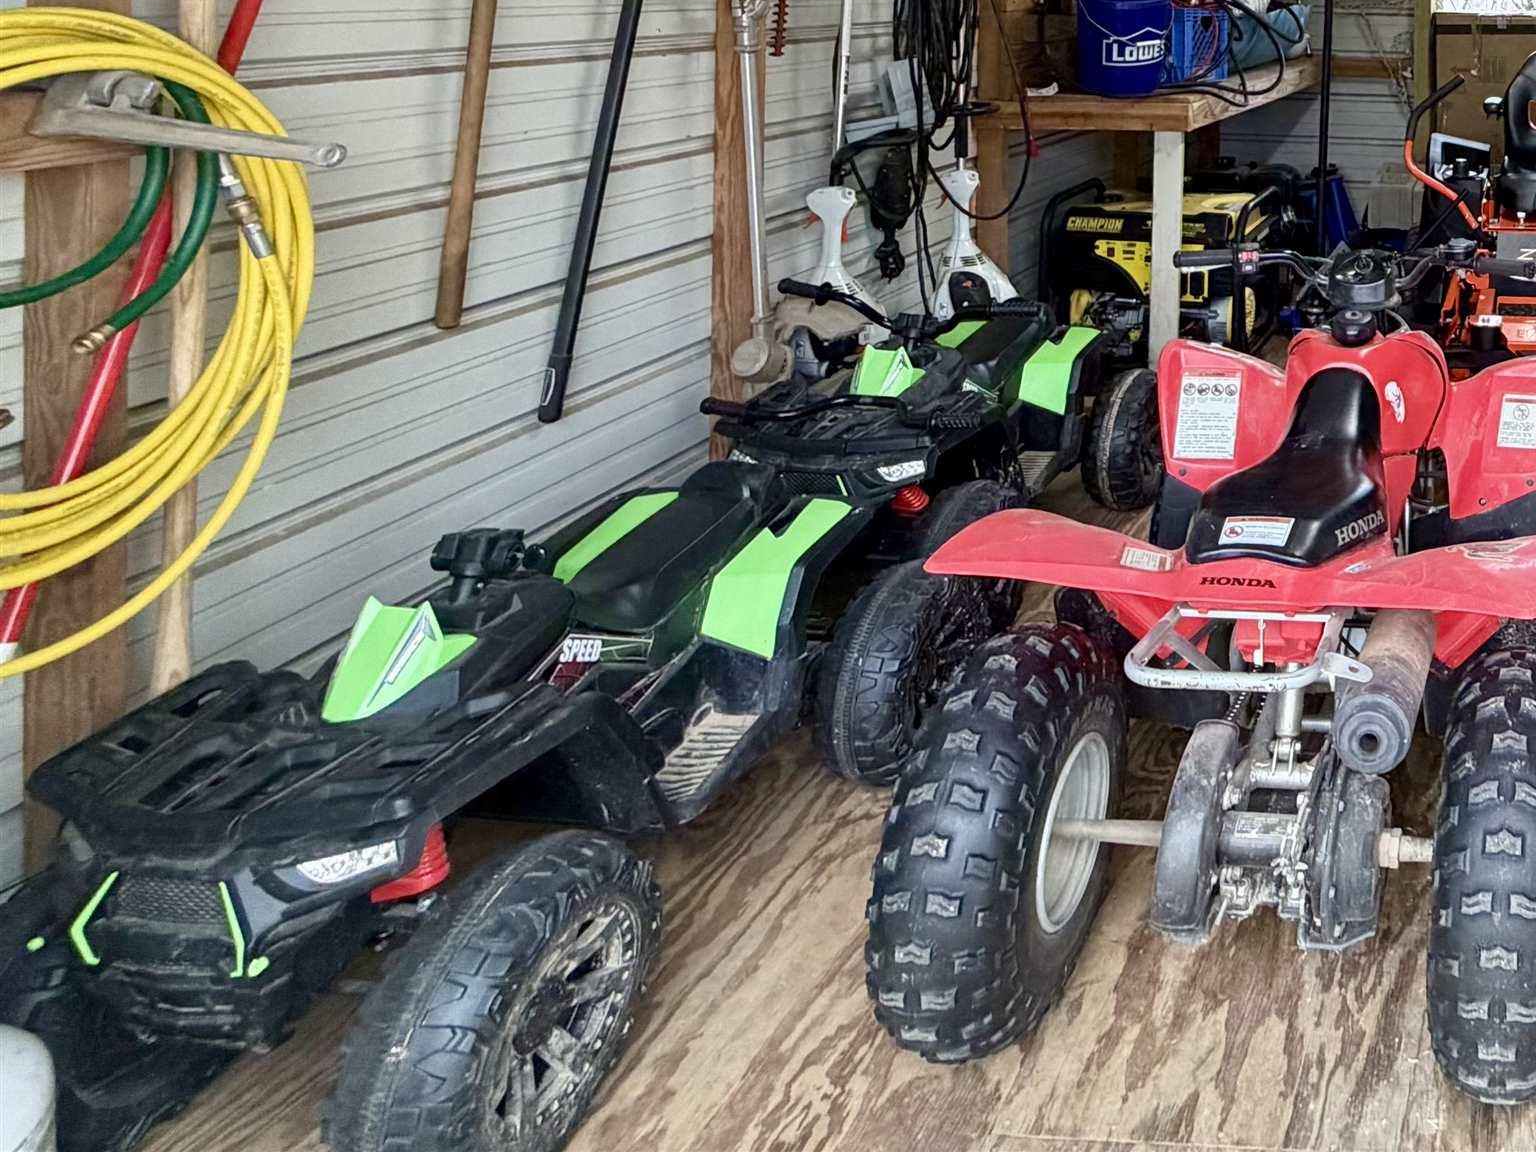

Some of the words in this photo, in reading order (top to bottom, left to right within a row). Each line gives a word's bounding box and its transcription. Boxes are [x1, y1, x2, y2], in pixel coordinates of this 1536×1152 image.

[1066, 216, 1125, 232] CHAMPION
[1334, 509, 1386, 547] HONDA
[1199, 577, 1277, 589] HONDA
[560, 638, 602, 663] SPEED
